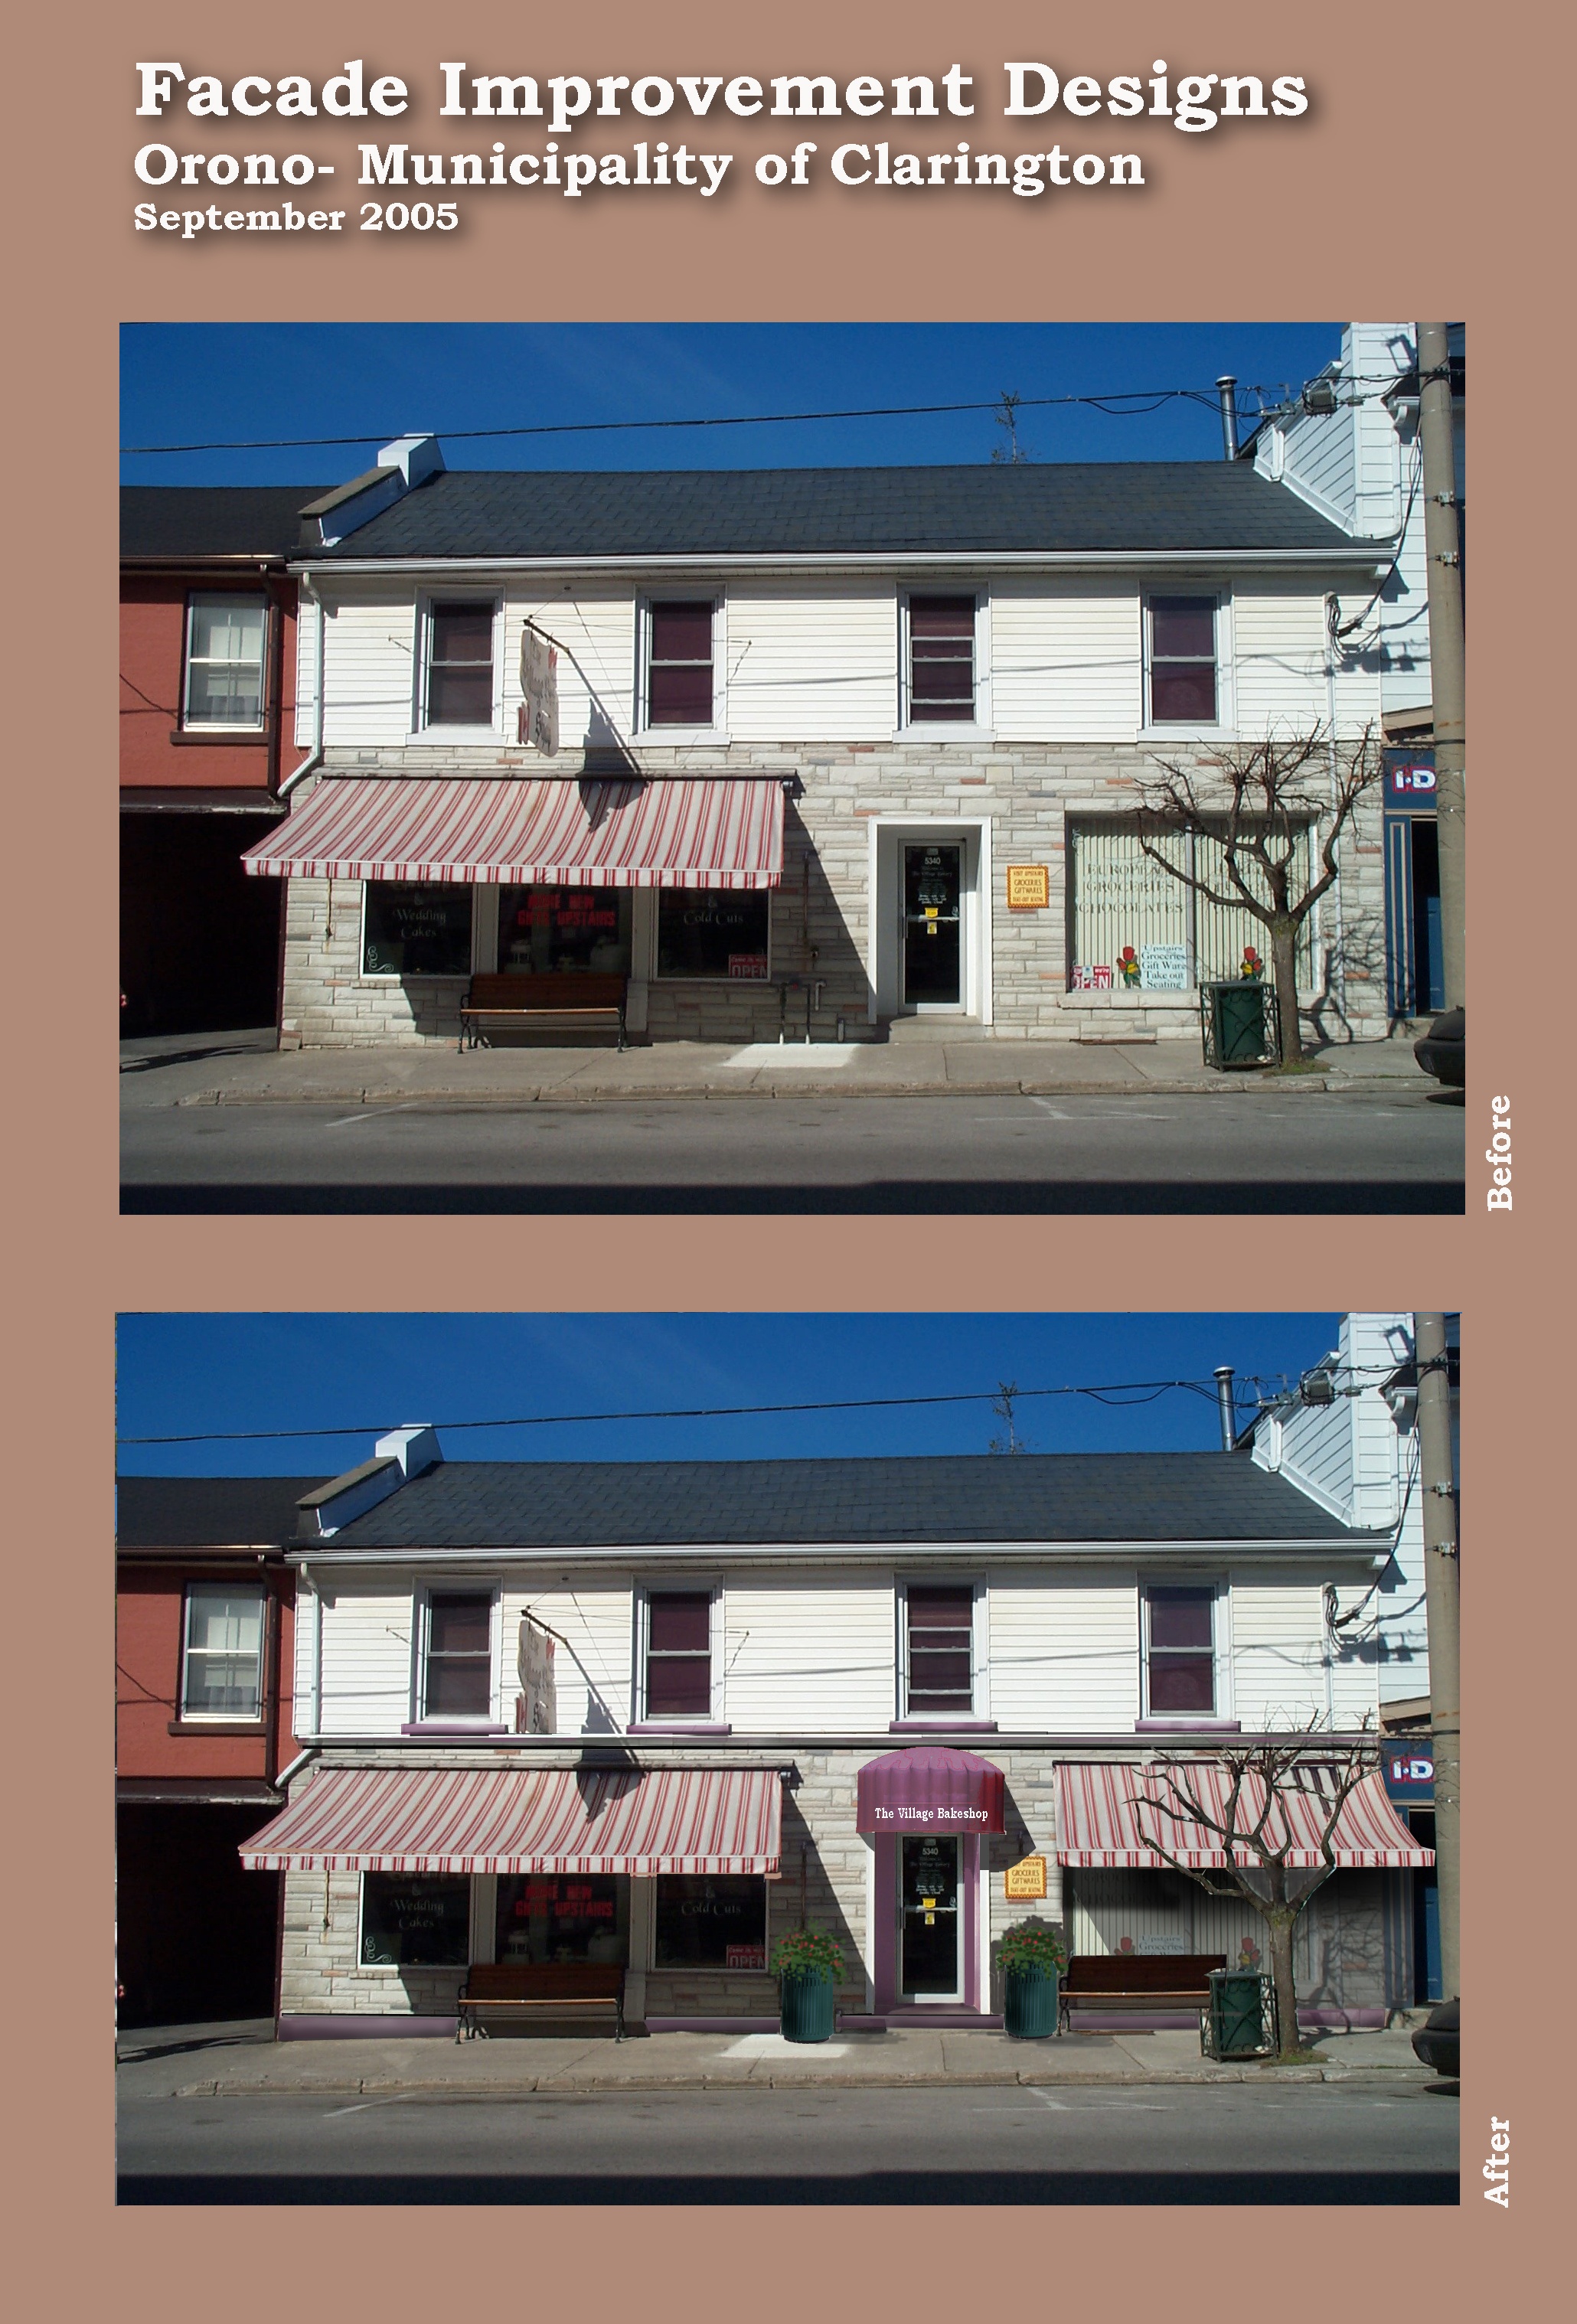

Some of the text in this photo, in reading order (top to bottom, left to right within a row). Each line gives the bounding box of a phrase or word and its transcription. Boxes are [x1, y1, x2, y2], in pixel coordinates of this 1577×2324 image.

[925, 857, 941, 865] 5340
[874, 1807, 988, 1822] The Village Bakeshop
[922, 1847, 939, 1856] 5340
